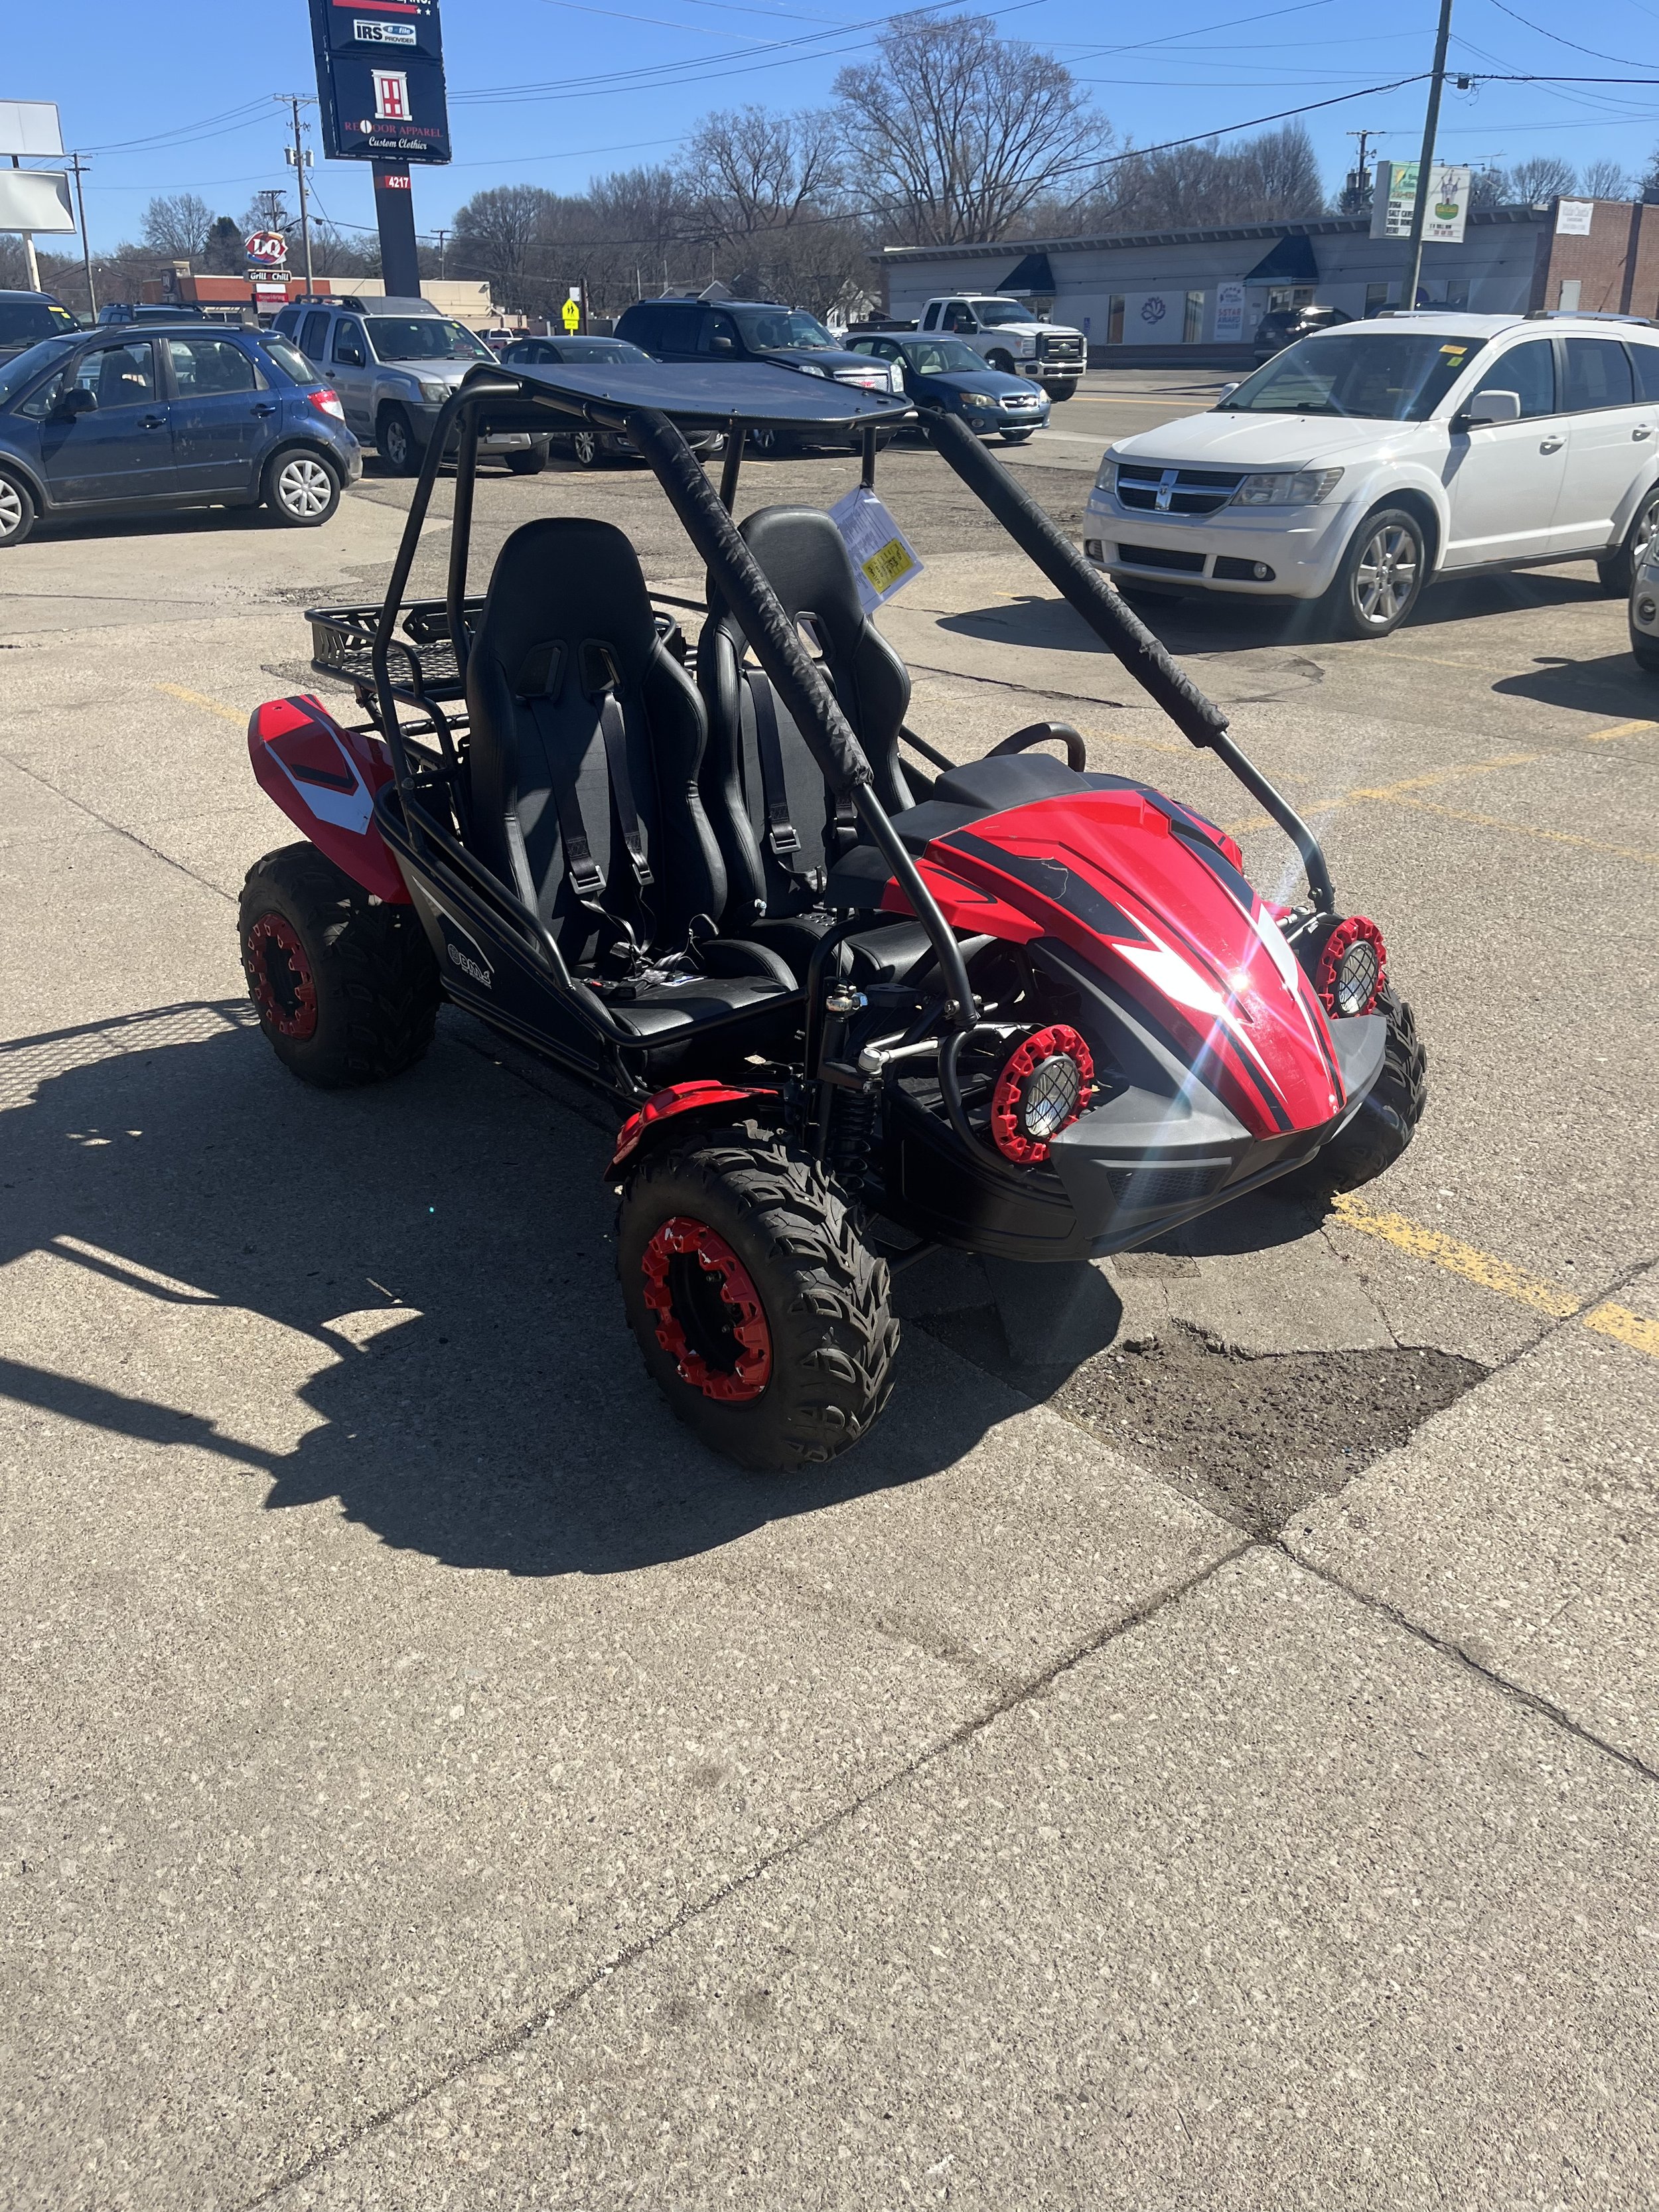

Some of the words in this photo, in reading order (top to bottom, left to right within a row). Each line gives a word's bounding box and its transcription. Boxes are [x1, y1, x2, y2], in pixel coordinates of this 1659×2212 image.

[356, 25, 383, 40] IRS
[399, 126, 443, 138] APPAREL
[368, 136, 397, 148] Custom
[398, 137, 427, 150] Clothier
[389, 176, 409, 188] 4217
[253, 238, 281, 258] DQ
[271, 272, 289, 281] Chill
